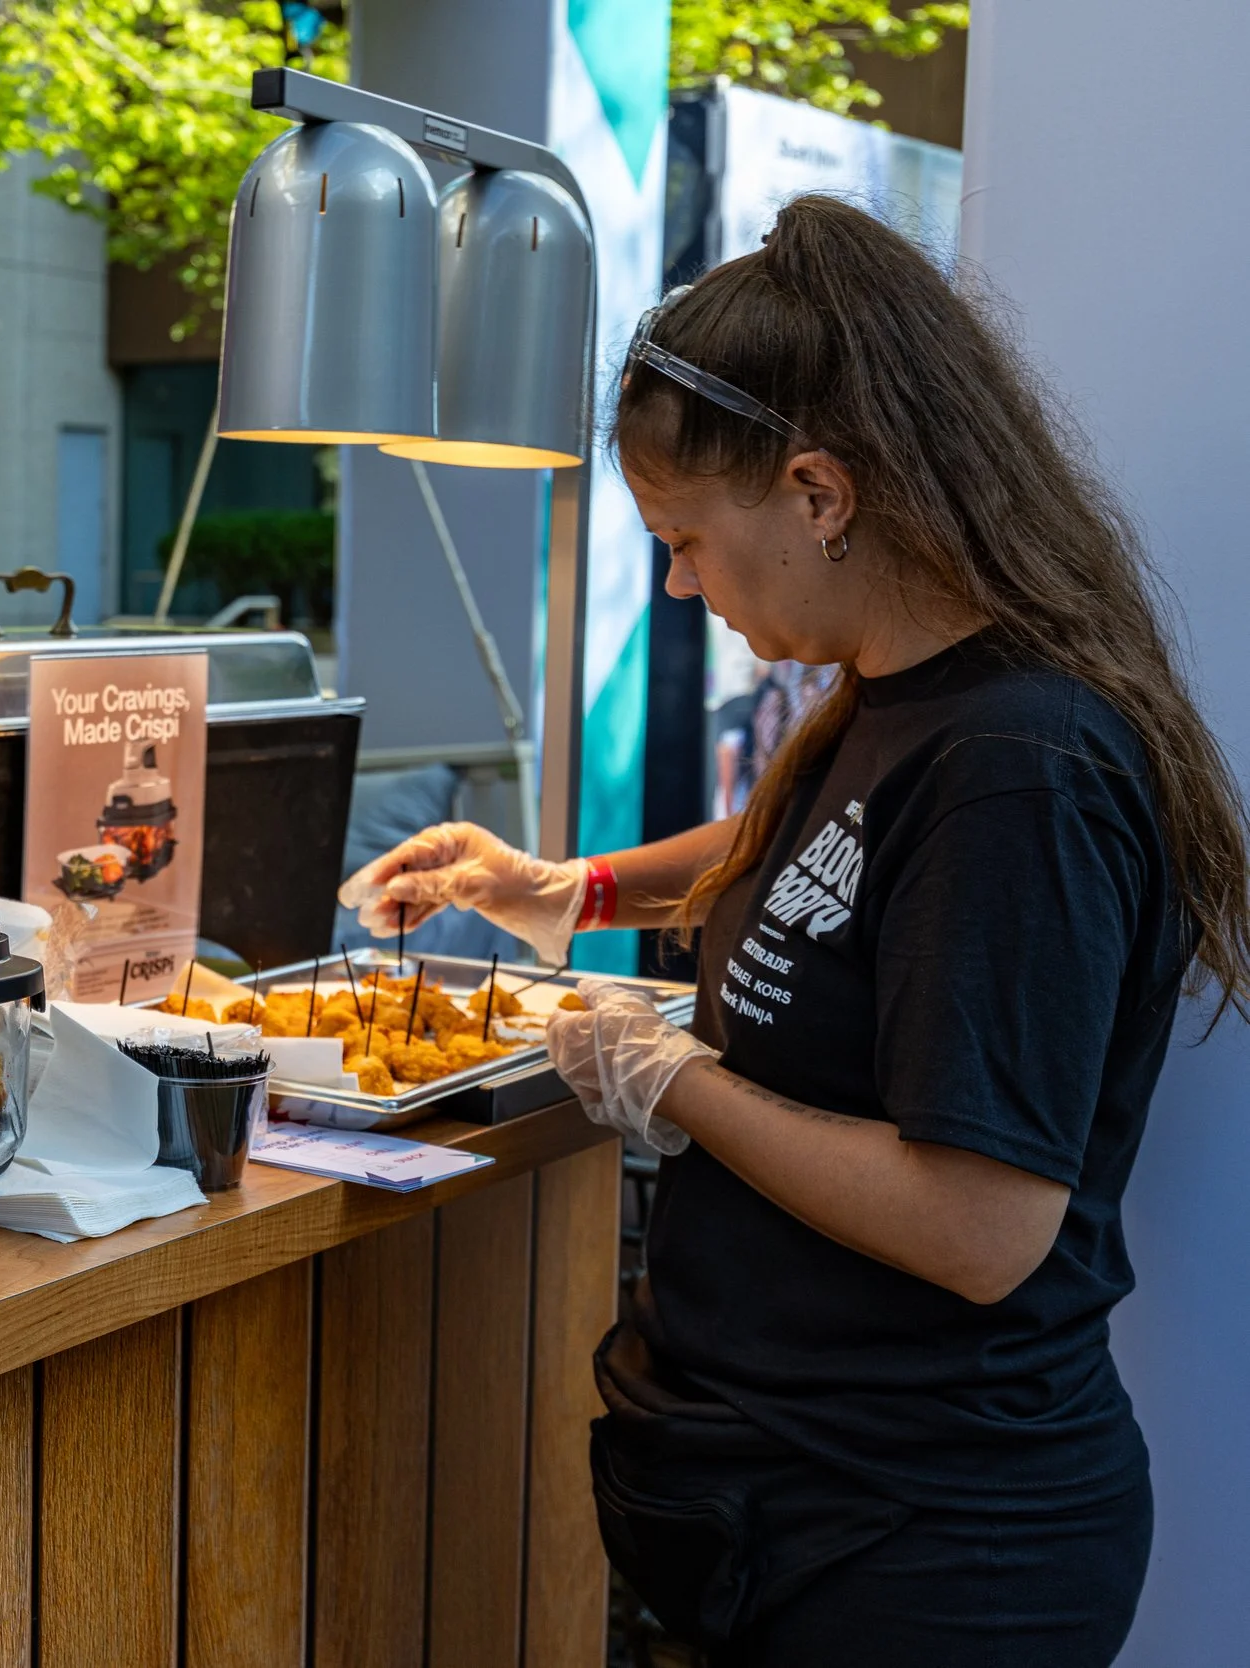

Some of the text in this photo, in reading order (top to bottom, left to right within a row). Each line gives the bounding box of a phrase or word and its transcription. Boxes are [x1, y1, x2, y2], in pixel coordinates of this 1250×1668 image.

[52, 683, 190, 715] Your Cravings,
[63, 711, 180, 746] Made Crispi
[763, 863, 852, 942] PARTY
[753, 979, 793, 1005] KORS
[738, 996, 774, 1026] NINJA
